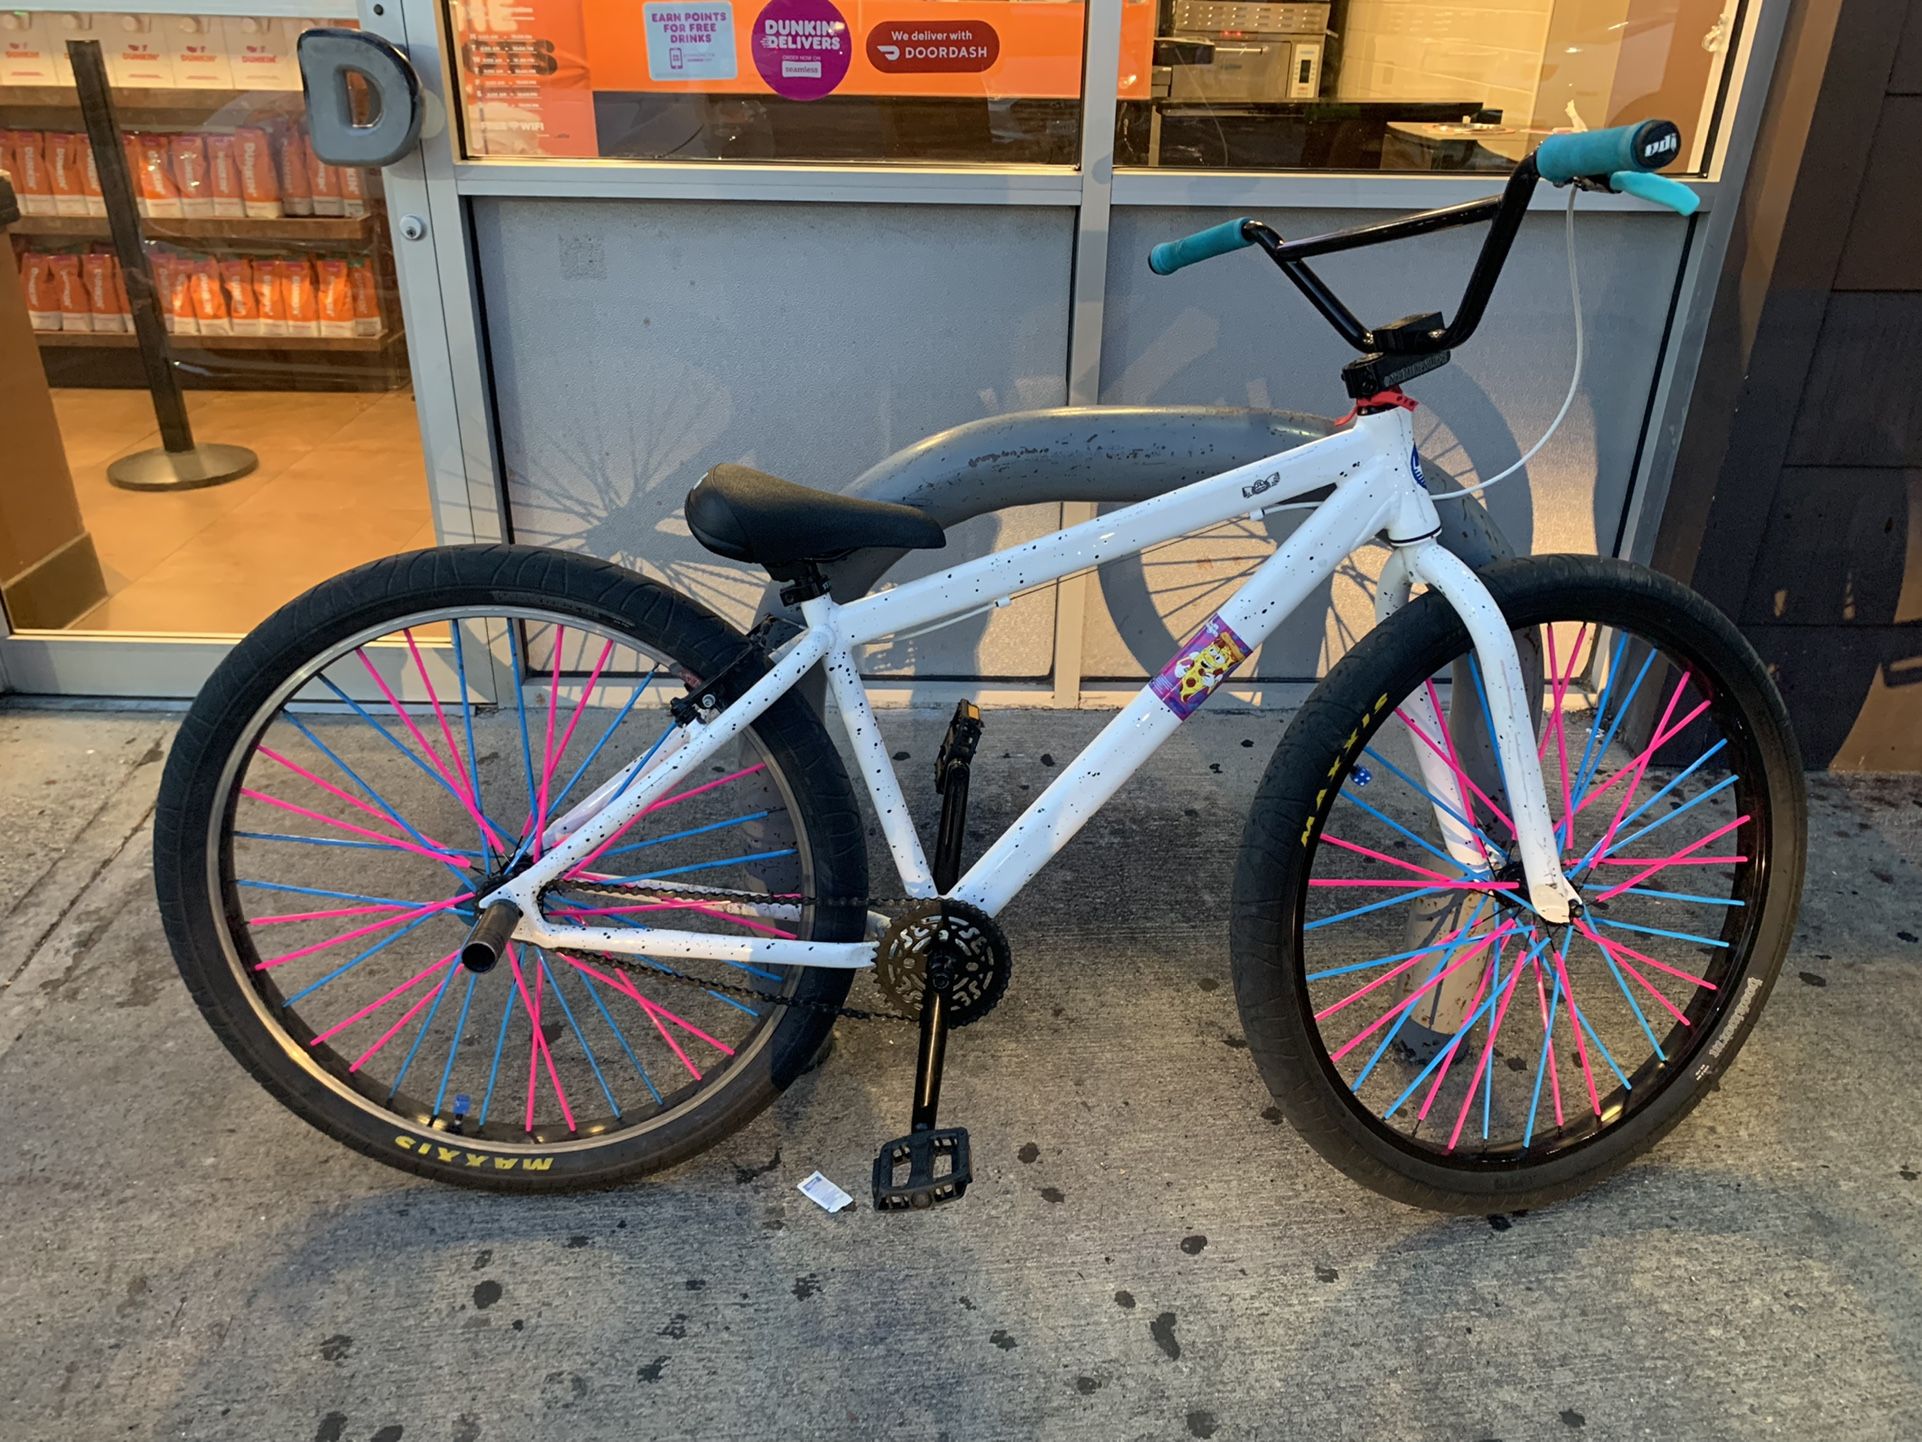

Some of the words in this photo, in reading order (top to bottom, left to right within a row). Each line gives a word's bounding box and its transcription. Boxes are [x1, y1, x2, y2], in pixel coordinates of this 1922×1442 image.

[651, 13, 681, 22] EARN
[685, 12, 727, 21] POINTS
[663, 24, 686, 33] FOR
[689, 23, 717, 32] FREE
[670, 34, 712, 43] DRINKS
[891, 31, 909, 41] We
[911, 30, 947, 41] deliver
[949, 30, 973, 40] with
[763, 35, 840, 50] DELIVERS
[905, 46, 988, 59] DOORDASH
[785, 66, 818, 74] seamless
[243, 142, 258, 197] DUNKIN'
[1300, 692, 1388, 848] MAXXIS
[394, 1134, 555, 1171] MAXXIS
